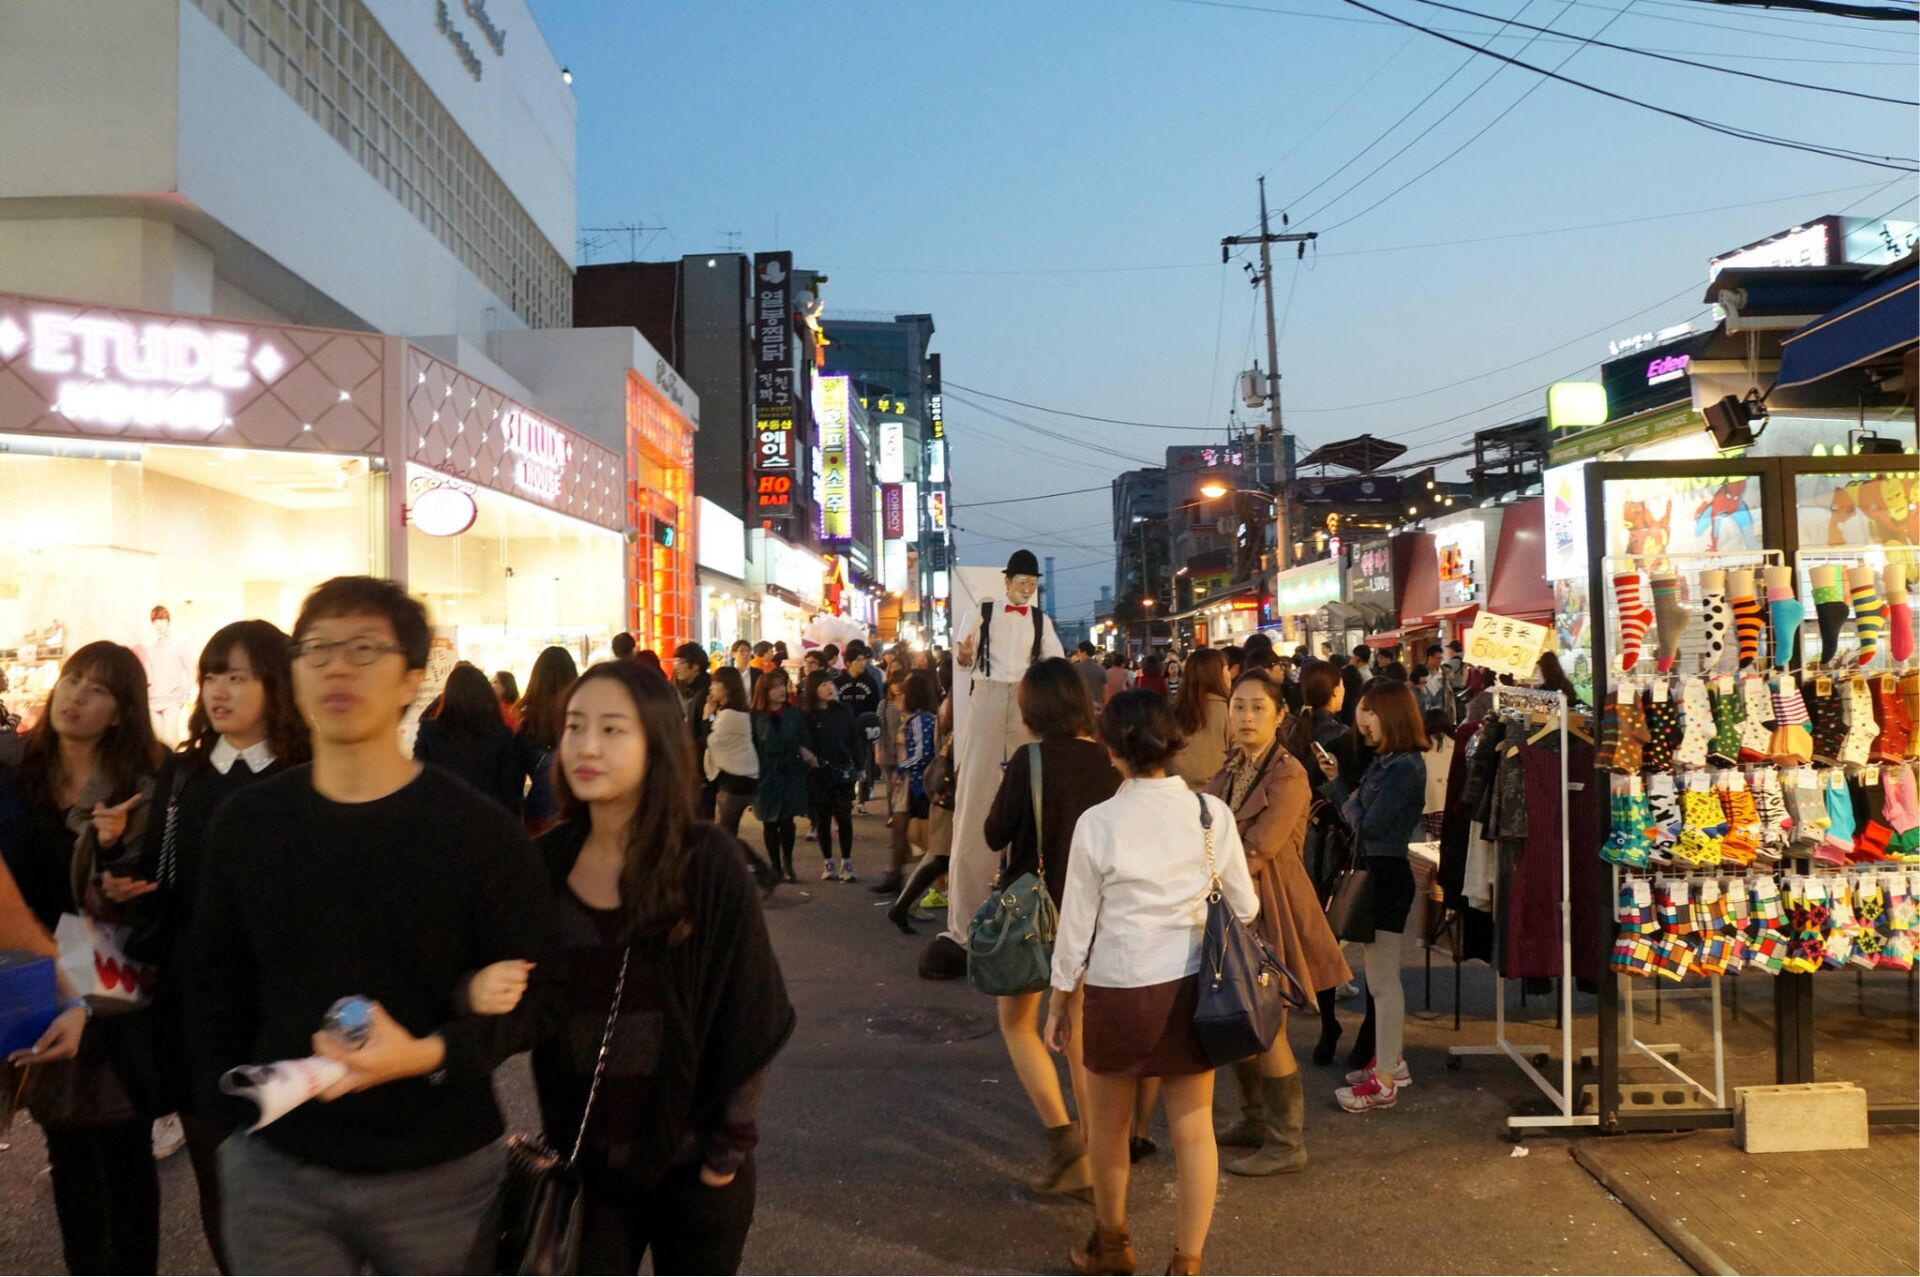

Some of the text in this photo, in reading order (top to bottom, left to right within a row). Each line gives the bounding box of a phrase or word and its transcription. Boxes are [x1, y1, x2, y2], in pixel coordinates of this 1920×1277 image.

[760, 289, 787, 361] 열봉찜닭
[29, 311, 252, 389] ETUDE
[1646, 354, 1690, 378] Eden
[760, 431, 790, 467] 에이스
[758, 476, 792, 494] HO
[759, 495, 789, 505] BAR
